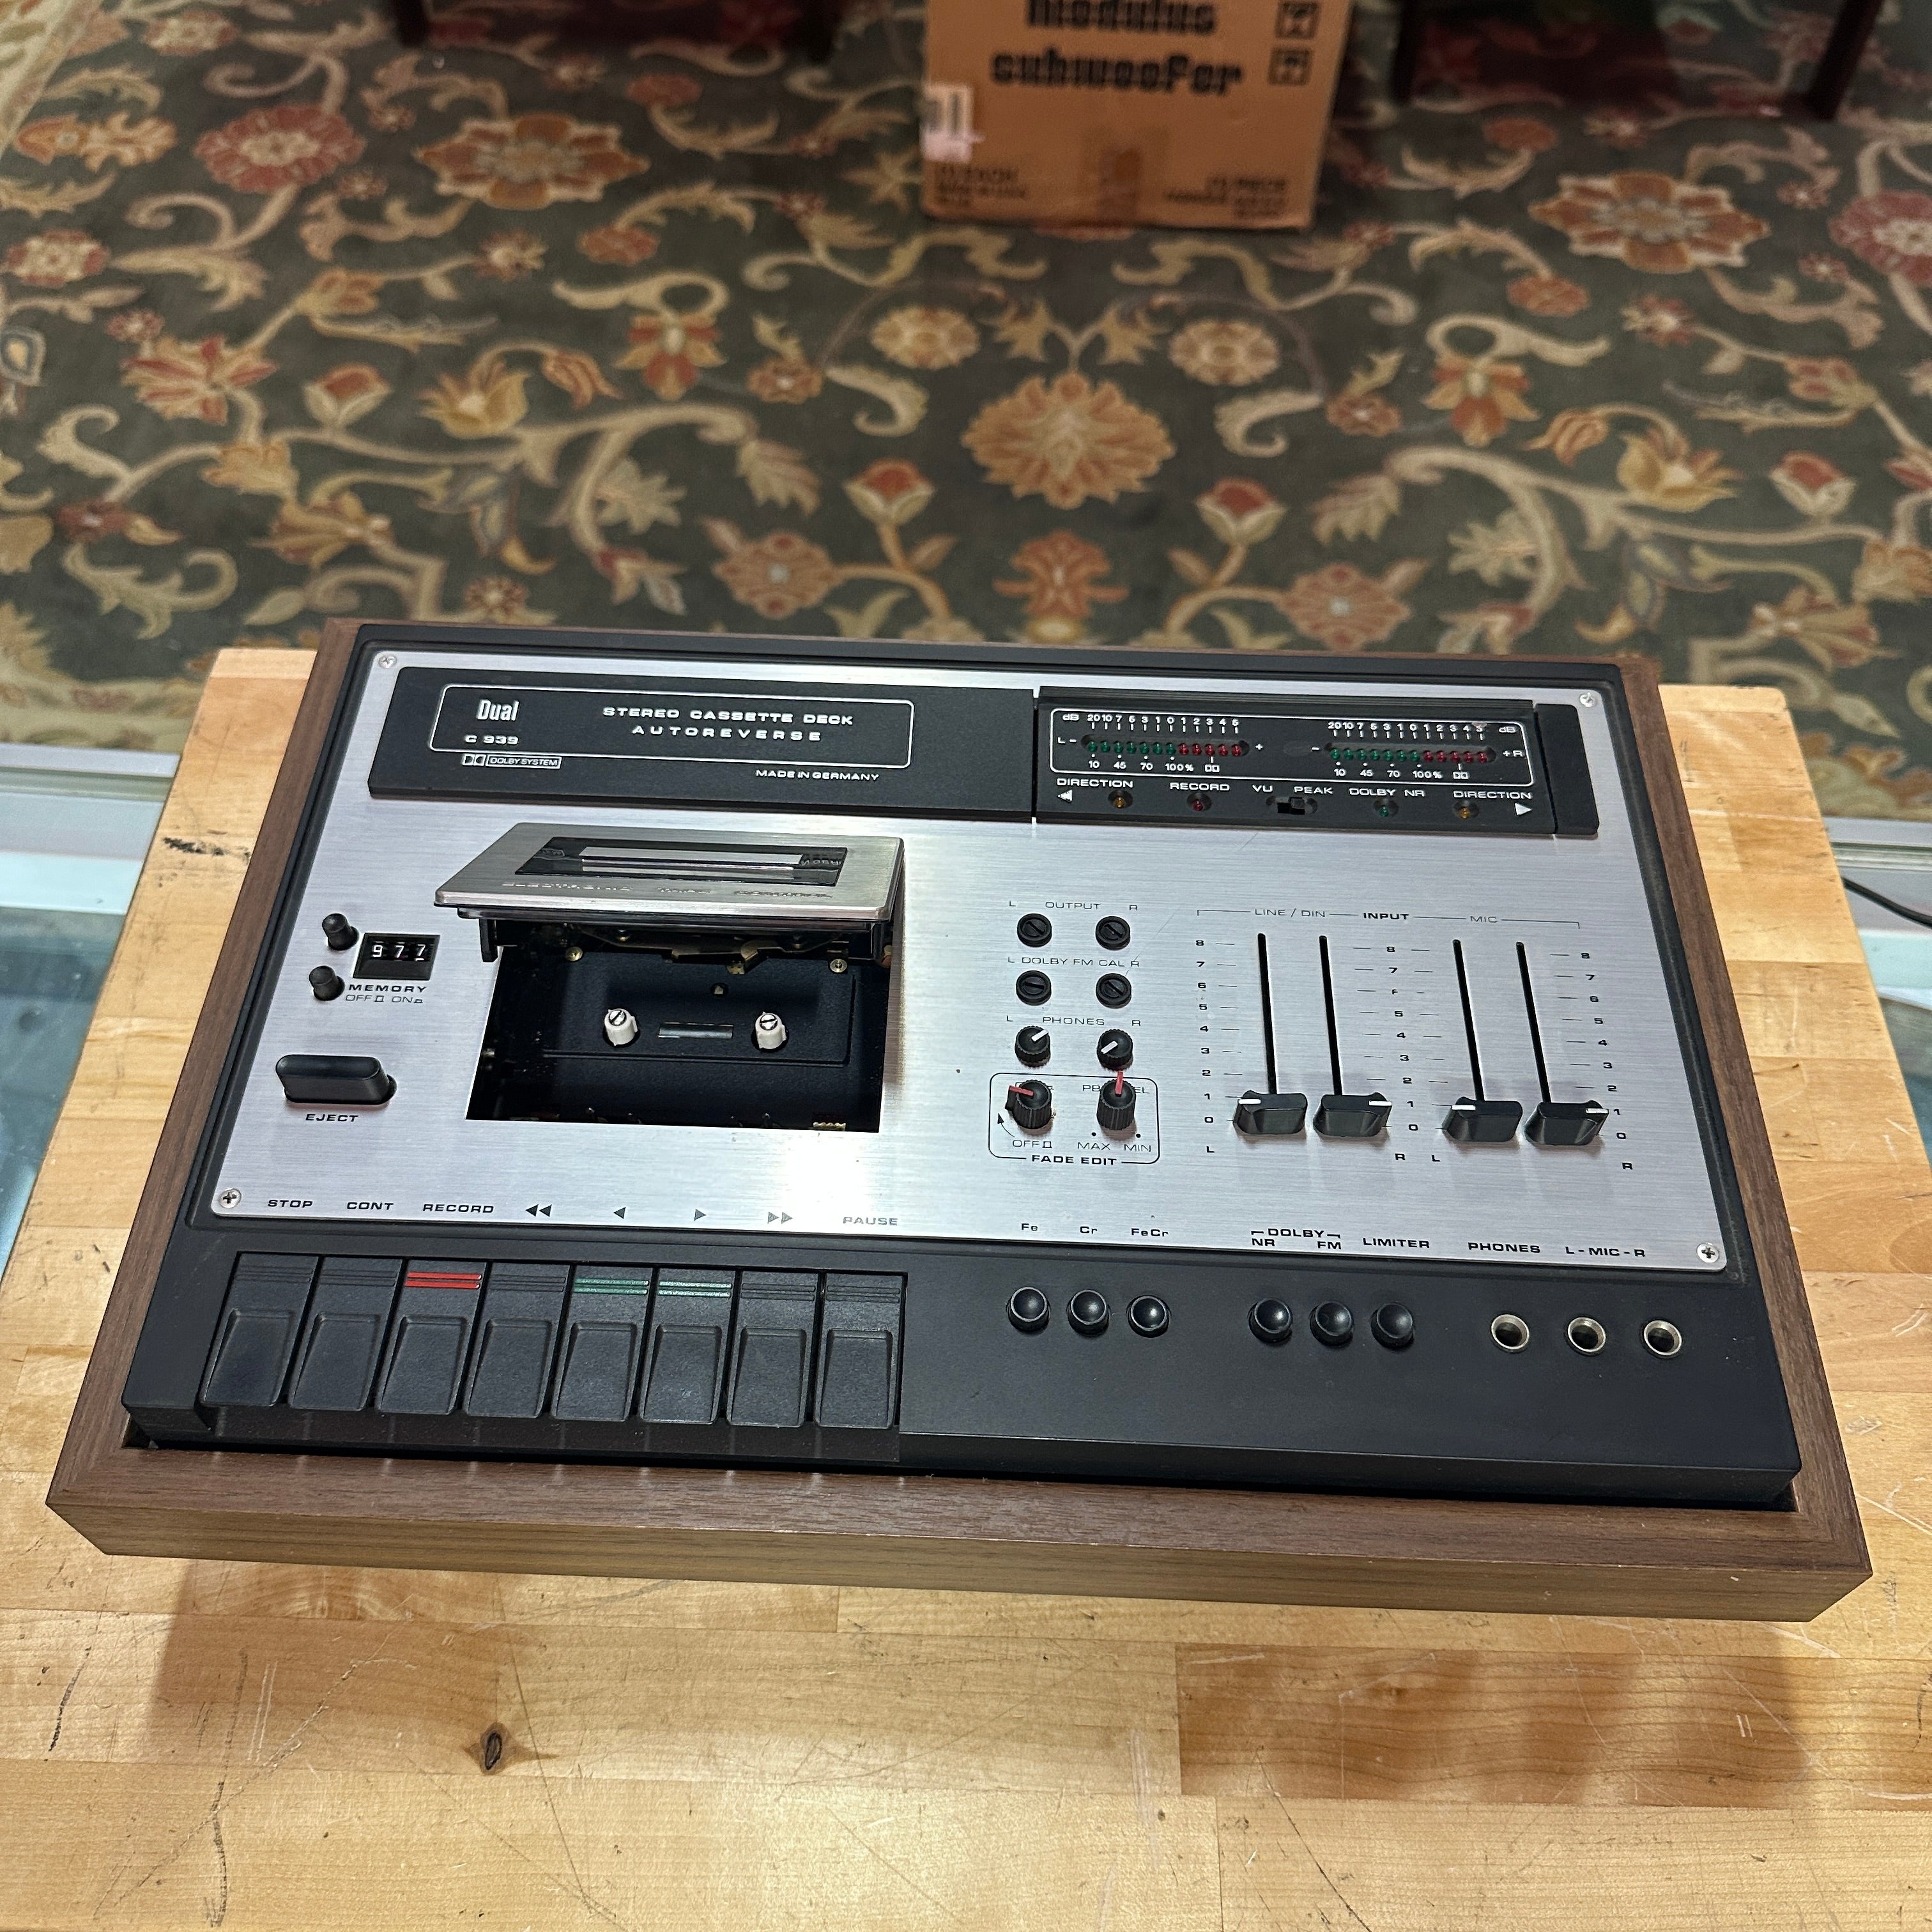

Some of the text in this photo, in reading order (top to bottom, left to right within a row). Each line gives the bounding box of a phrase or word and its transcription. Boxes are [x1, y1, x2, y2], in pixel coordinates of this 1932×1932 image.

[992, 47, 1243, 95] subwoofer
[477, 699, 519, 721] Dual
[602, 707, 854, 726] STEREO CASSETTE DECK
[1116, 714, 1122, 723] 7
[1167, 716, 1175, 724] 0
[1206, 717, 1213, 726] 3
[632, 726, 821, 742] AUTOREVERSE
[464, 735, 519, 745] C 939
[1089, 760, 1100, 769] 10
[1140, 762, 1153, 770] 70
[756, 770, 795, 778] MADE
[812, 772, 879, 781] GERMANY
[1334, 769, 1346, 777] 10
[1360, 769, 1374, 778] 45
[1387, 770, 1400, 778] 70
[1057, 778, 1133, 788] DIRECTION
[1170, 782, 1230, 792] RECORD
[1252, 785, 1273, 793] VU
[1294, 786, 1333, 795] PEAK
[1349, 788, 1396, 797] DOLBY
[1453, 790, 1532, 799] DIRECTION
[1045, 901, 1101, 910] OUTPUT
[1022, 956, 1068, 965] DOLBY
[348, 984, 427, 993] MEMORY
[346, 994, 413, 1004] OFF ON
[1043, 1016, 1105, 1025] PHONES
[305, 1114, 359, 1123] EJECT
[1077, 1142, 1111, 1150] MAX
[1124, 1144, 1151, 1153] MIN
[1032, 1155, 1117, 1165] FADE EDIT
[1621, 1162, 1634, 1170] R
[267, 1199, 313, 1208] STOP
[346, 1202, 394, 1211] CONT
[422, 1204, 494, 1213] RECORD
[843, 1216, 898, 1226] PAUSE
[1021, 1223, 1038, 1232] Fe
[1080, 1226, 1098, 1234] Cr
[1131, 1228, 1169, 1238] FeCr
[1268, 1228, 1325, 1238] DOLBY
[1252, 1238, 1275, 1247] NR
[1317, 1241, 1342, 1250] FM
[1363, 1238, 1430, 1248] LIMITER
[1468, 1242, 1540, 1254] PHONES
